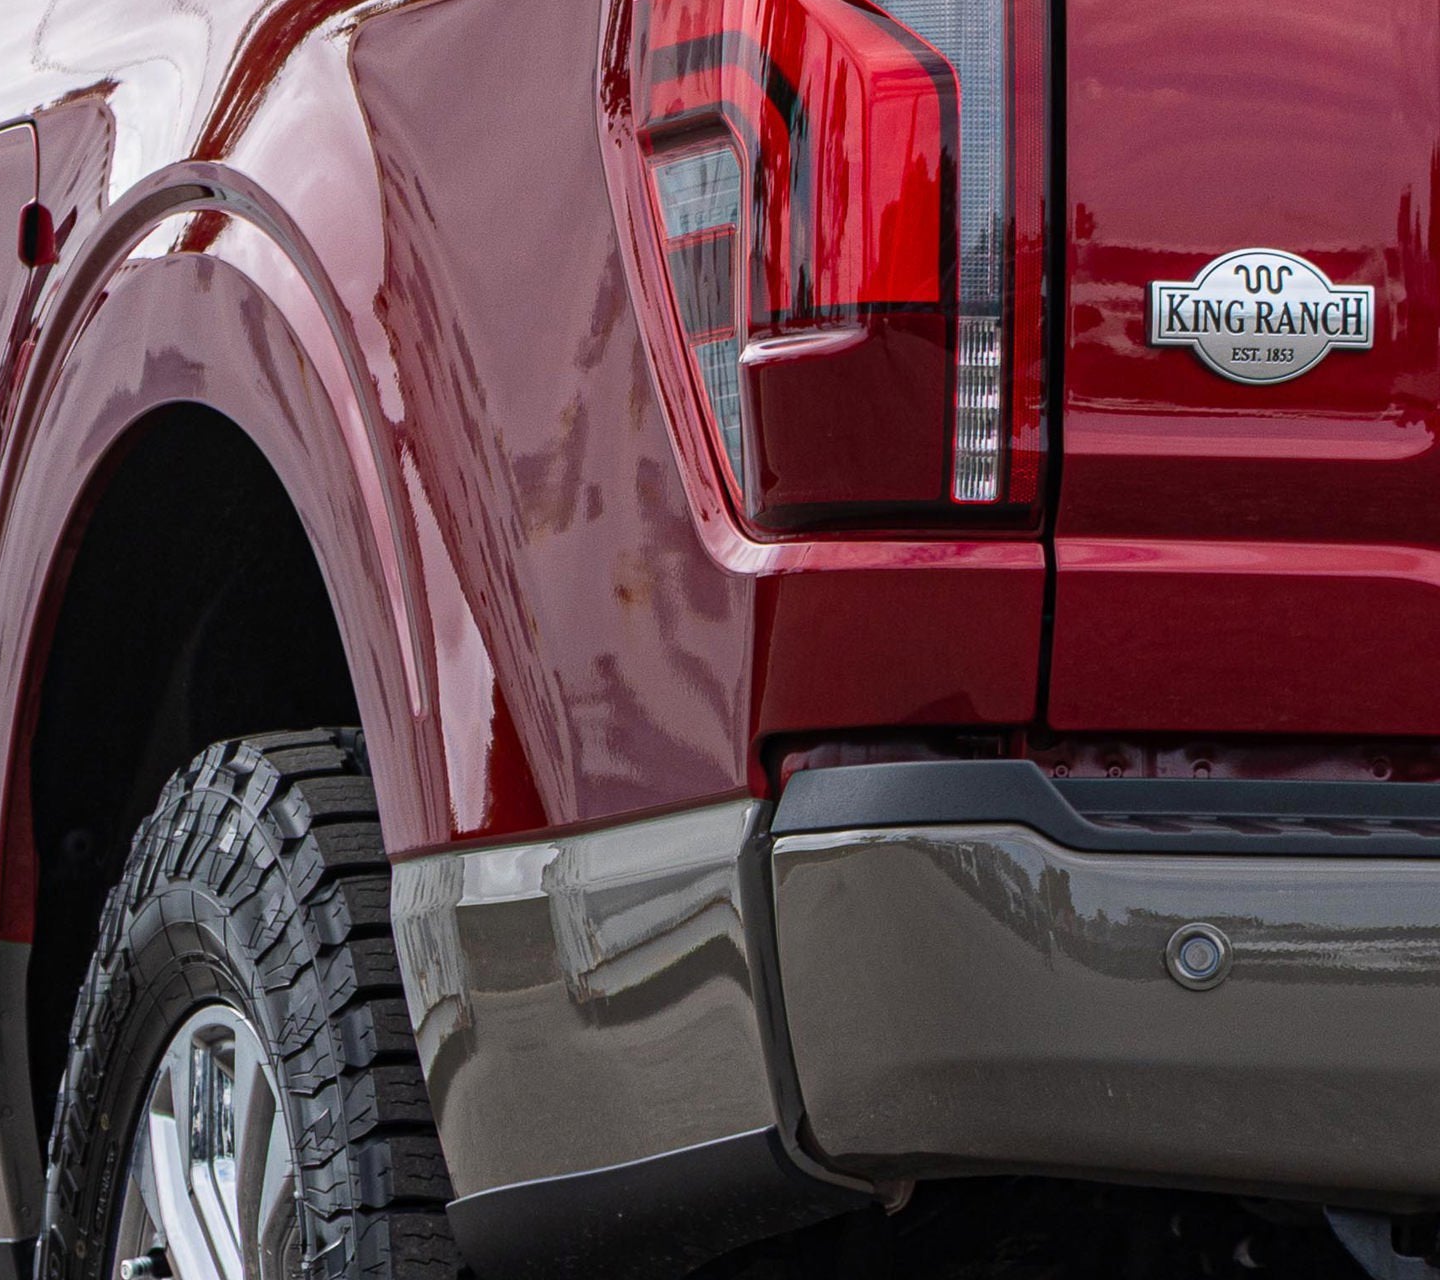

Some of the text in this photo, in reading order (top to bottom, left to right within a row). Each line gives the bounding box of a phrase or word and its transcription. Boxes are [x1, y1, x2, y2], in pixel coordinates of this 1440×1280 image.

[1165, 293, 1364, 336] KING RANCH
[1231, 346, 1295, 363] EST. 1853
